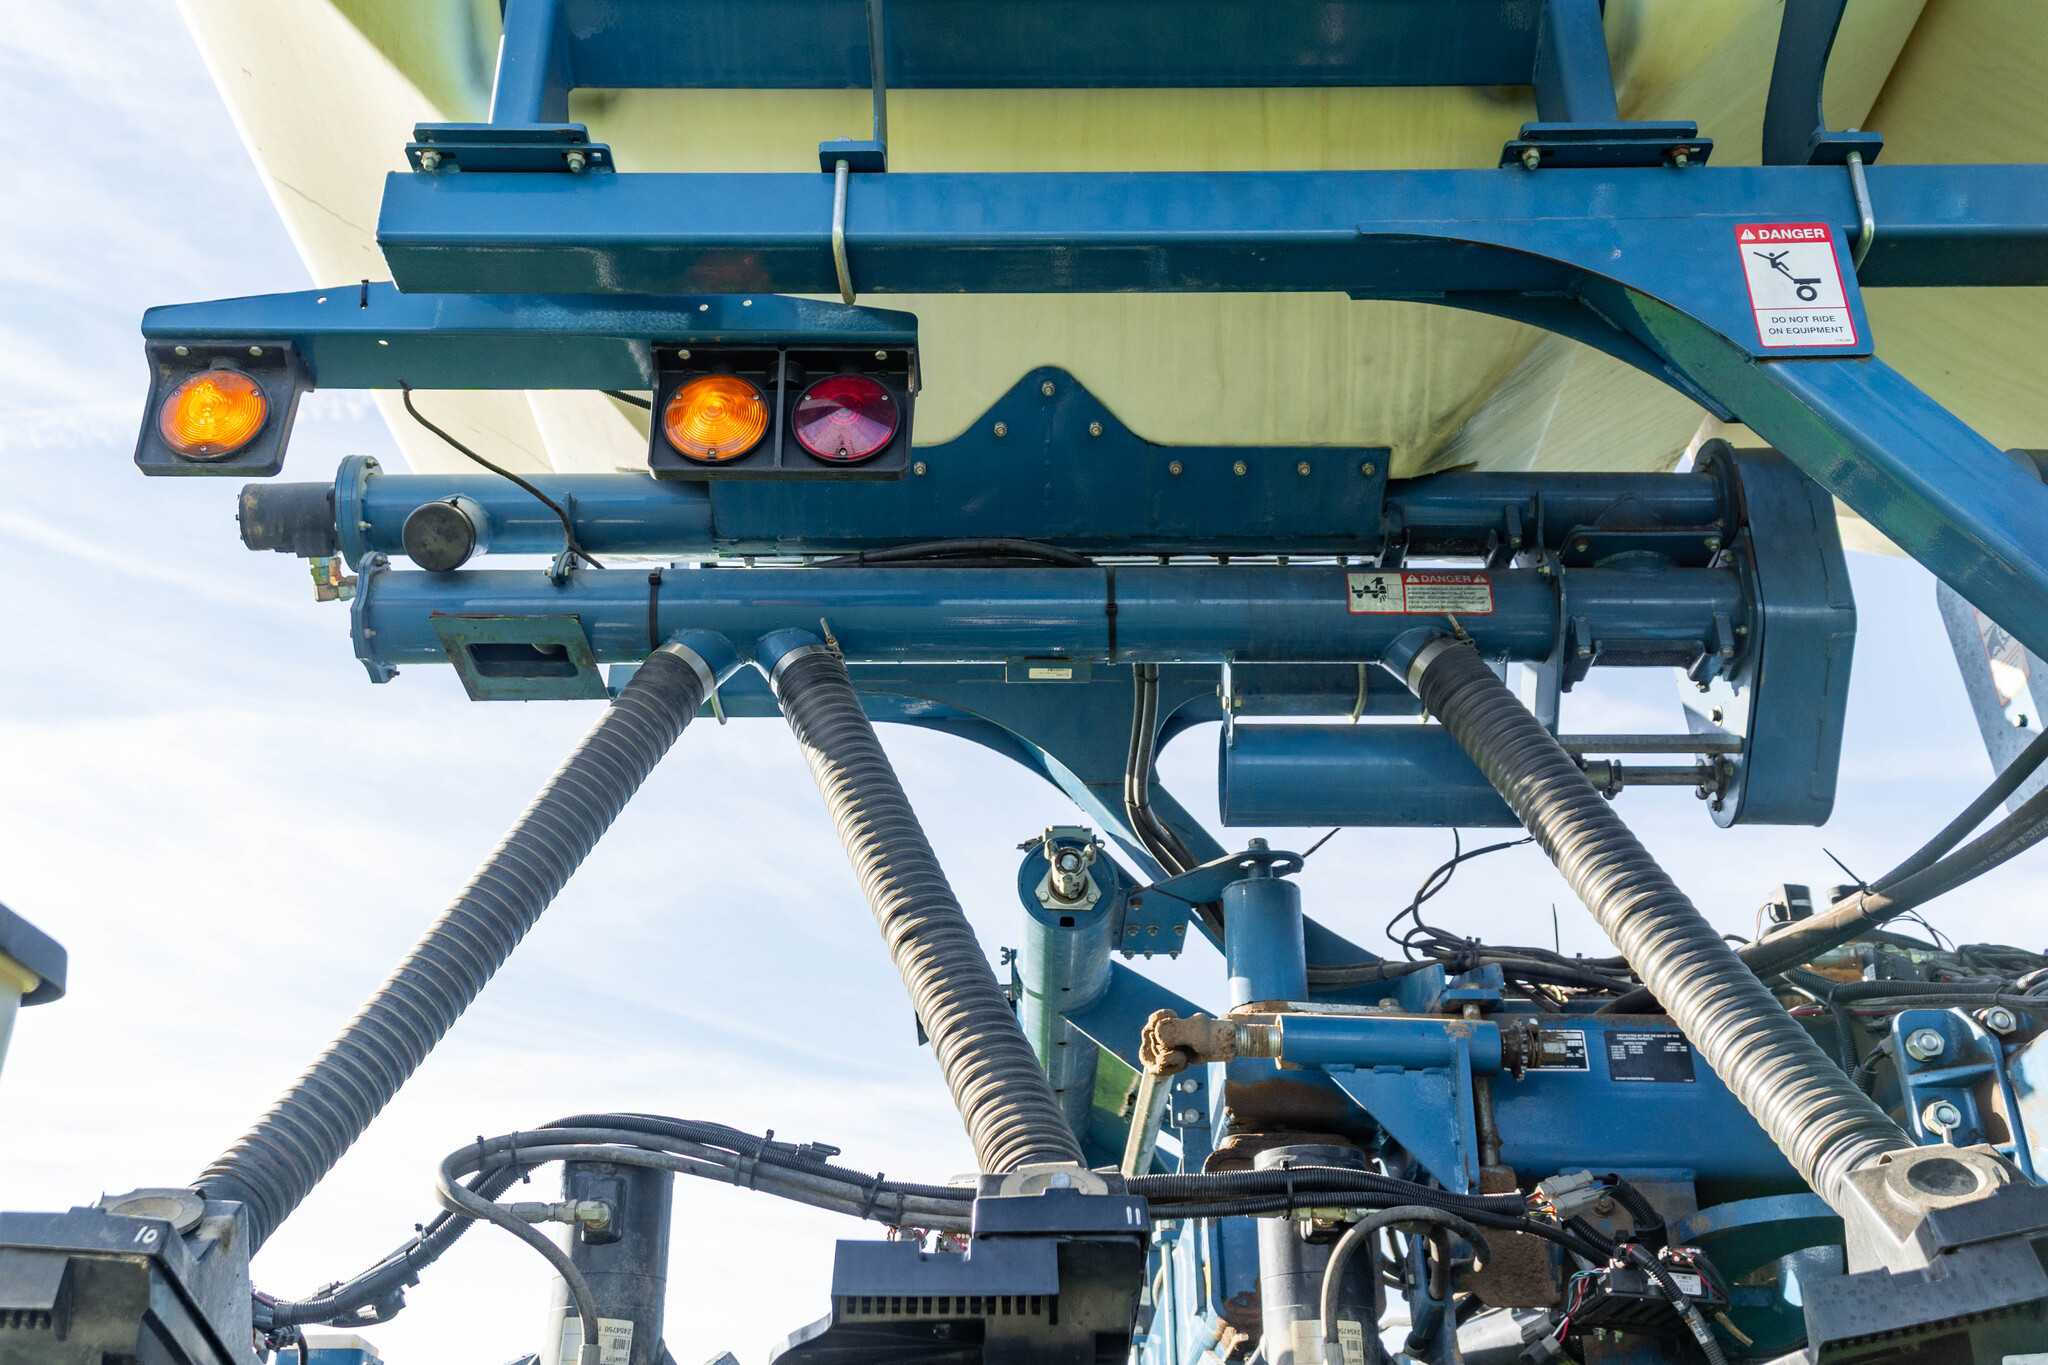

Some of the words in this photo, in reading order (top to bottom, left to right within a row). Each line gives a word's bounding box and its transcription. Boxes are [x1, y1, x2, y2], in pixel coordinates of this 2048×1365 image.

[1758, 228, 1825, 240] DANGER
[1788, 315, 1809, 323] NOT
[1768, 327, 1783, 335] ON
[1786, 326, 1843, 335] EQUIPMENT
[1420, 575, 1471, 583] DANGER
[133, 1225, 158, 1244] 10
[604, 1326, 632, 1334] 2454750
